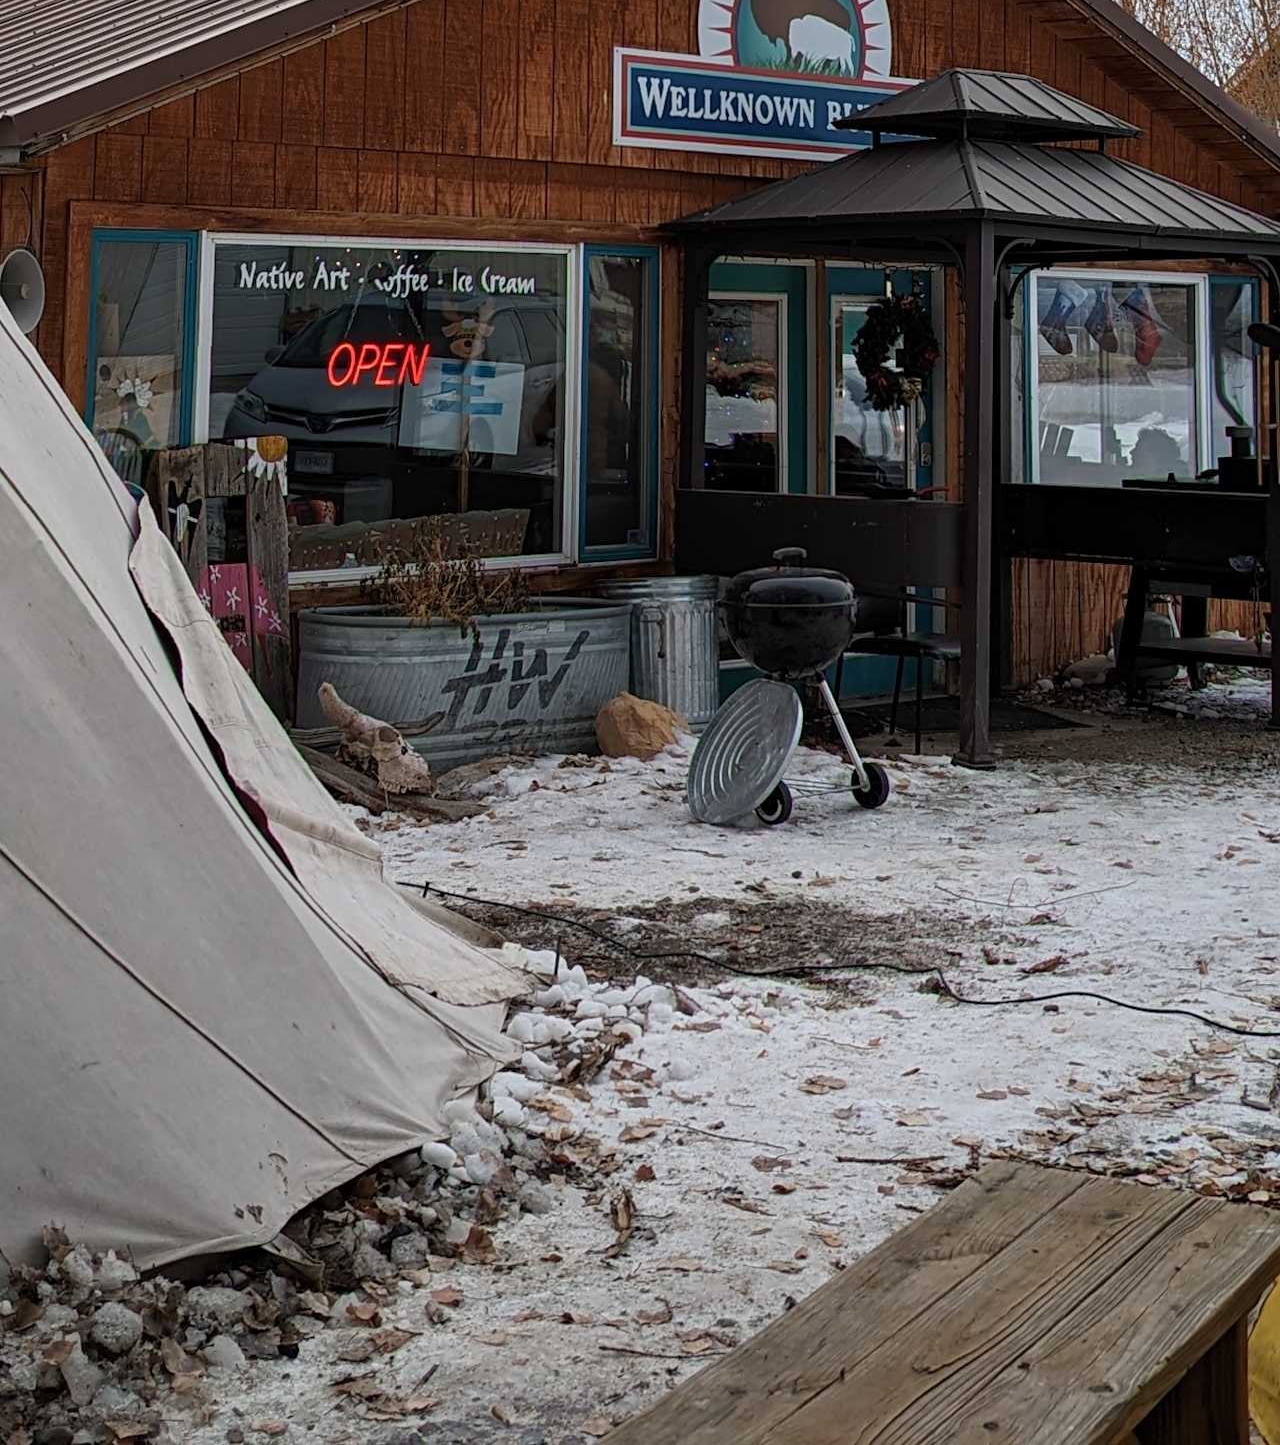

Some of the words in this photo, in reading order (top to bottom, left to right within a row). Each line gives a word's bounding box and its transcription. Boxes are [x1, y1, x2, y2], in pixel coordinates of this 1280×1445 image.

[637, 76, 816, 129] WELLKNOWN
[240, 261, 304, 289] Native
[313, 261, 350, 290] Art
[452, 267, 473, 292] Ice
[481, 266, 535, 294] Cream
[327, 342, 430, 387] OPEN
